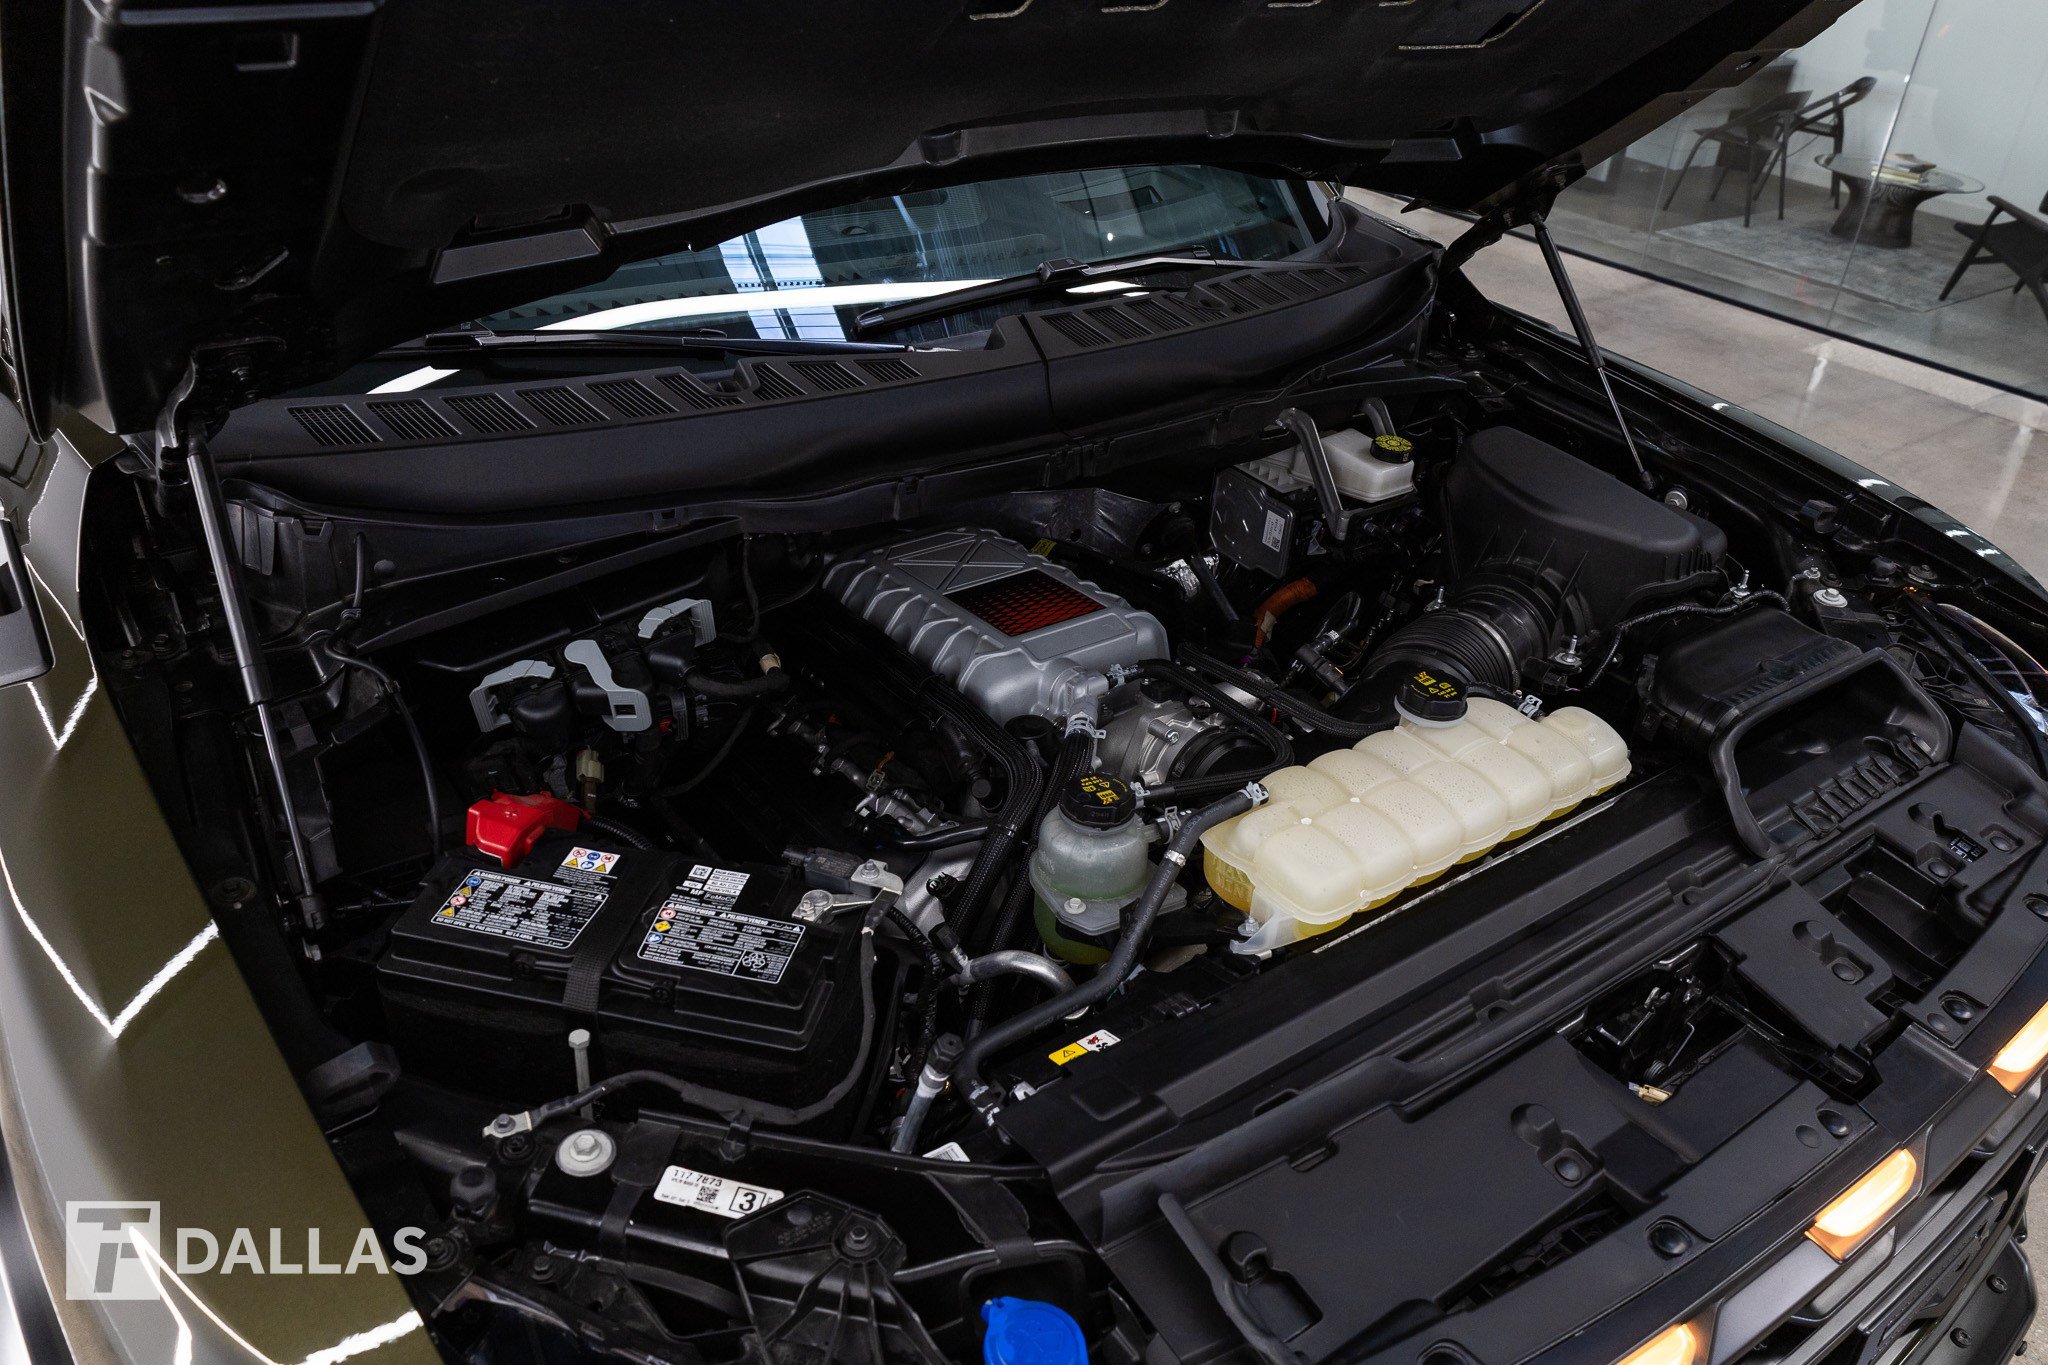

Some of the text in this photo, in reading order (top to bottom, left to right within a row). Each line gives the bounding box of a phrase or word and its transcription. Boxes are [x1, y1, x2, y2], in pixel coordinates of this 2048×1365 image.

[705, 893, 736, 903] FoMoCo
[696, 1175, 723, 1188] 7873
[738, 1191, 757, 1213] 3
